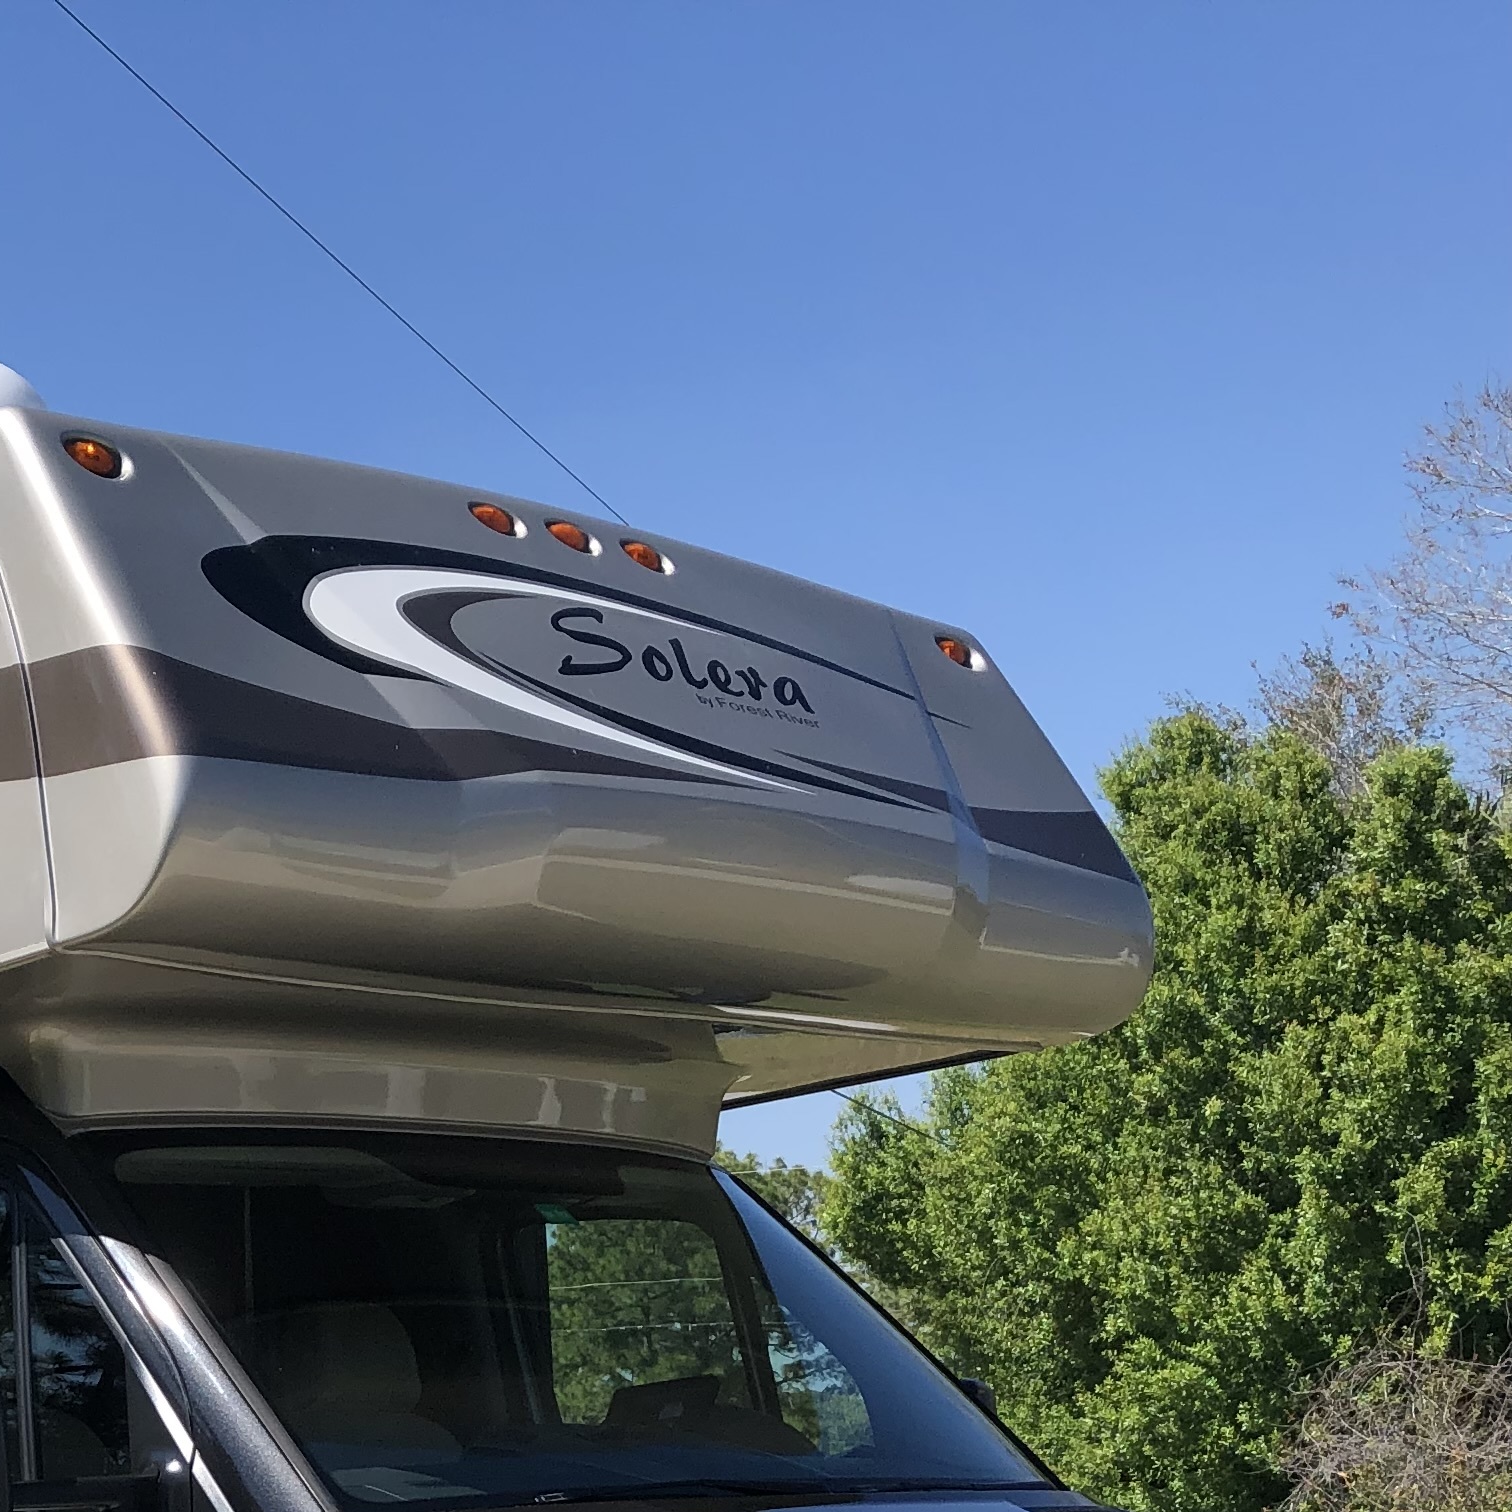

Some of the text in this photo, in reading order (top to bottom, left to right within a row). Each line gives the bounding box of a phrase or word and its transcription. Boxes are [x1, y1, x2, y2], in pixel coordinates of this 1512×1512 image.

[550, 606, 816, 715] Solera
[695, 692, 820, 729] by Forest River
